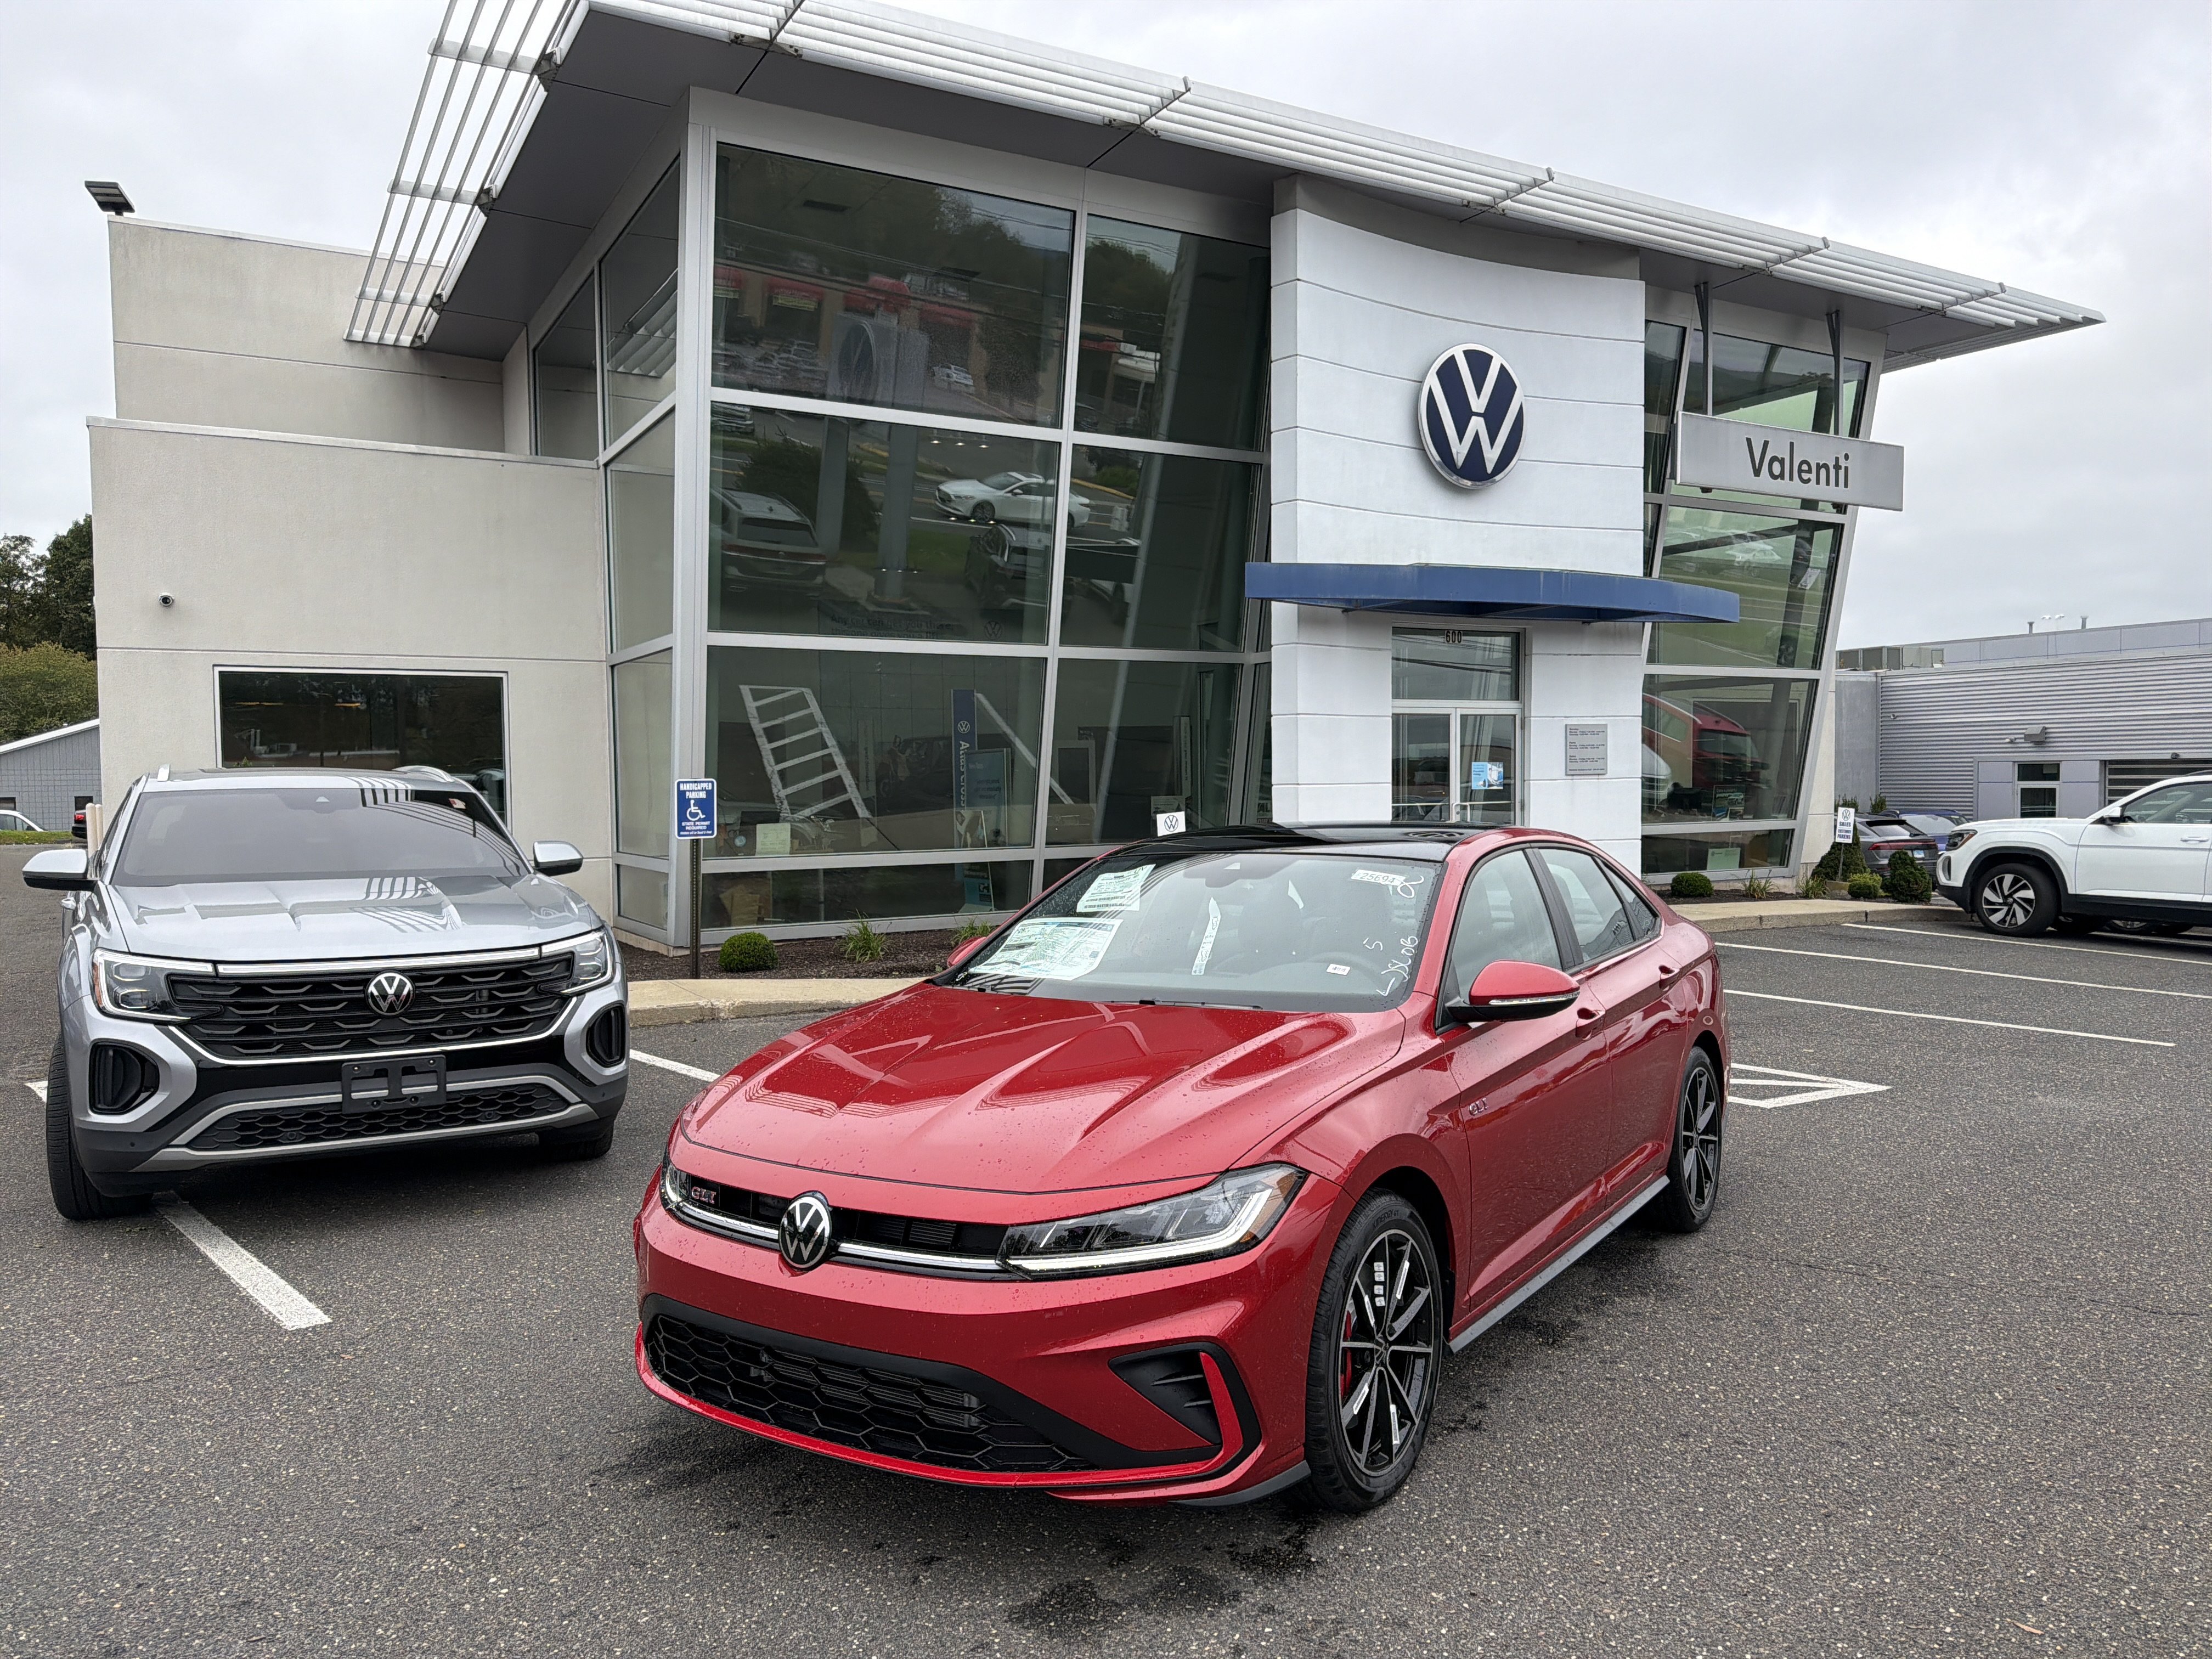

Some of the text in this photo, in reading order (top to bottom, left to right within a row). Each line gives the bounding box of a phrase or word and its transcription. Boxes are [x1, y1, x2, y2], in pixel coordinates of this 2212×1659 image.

[1745, 437, 1850, 489] Valenti
[1446, 631, 1462, 643] 600
[680, 782, 712, 791] HANDICAPPED
[686, 791, 707, 799] PARKING
[1360, 872, 1396, 884] 25694
[1469, 1097, 1489, 1116] GLI
[691, 1186, 716, 1204] GLI
